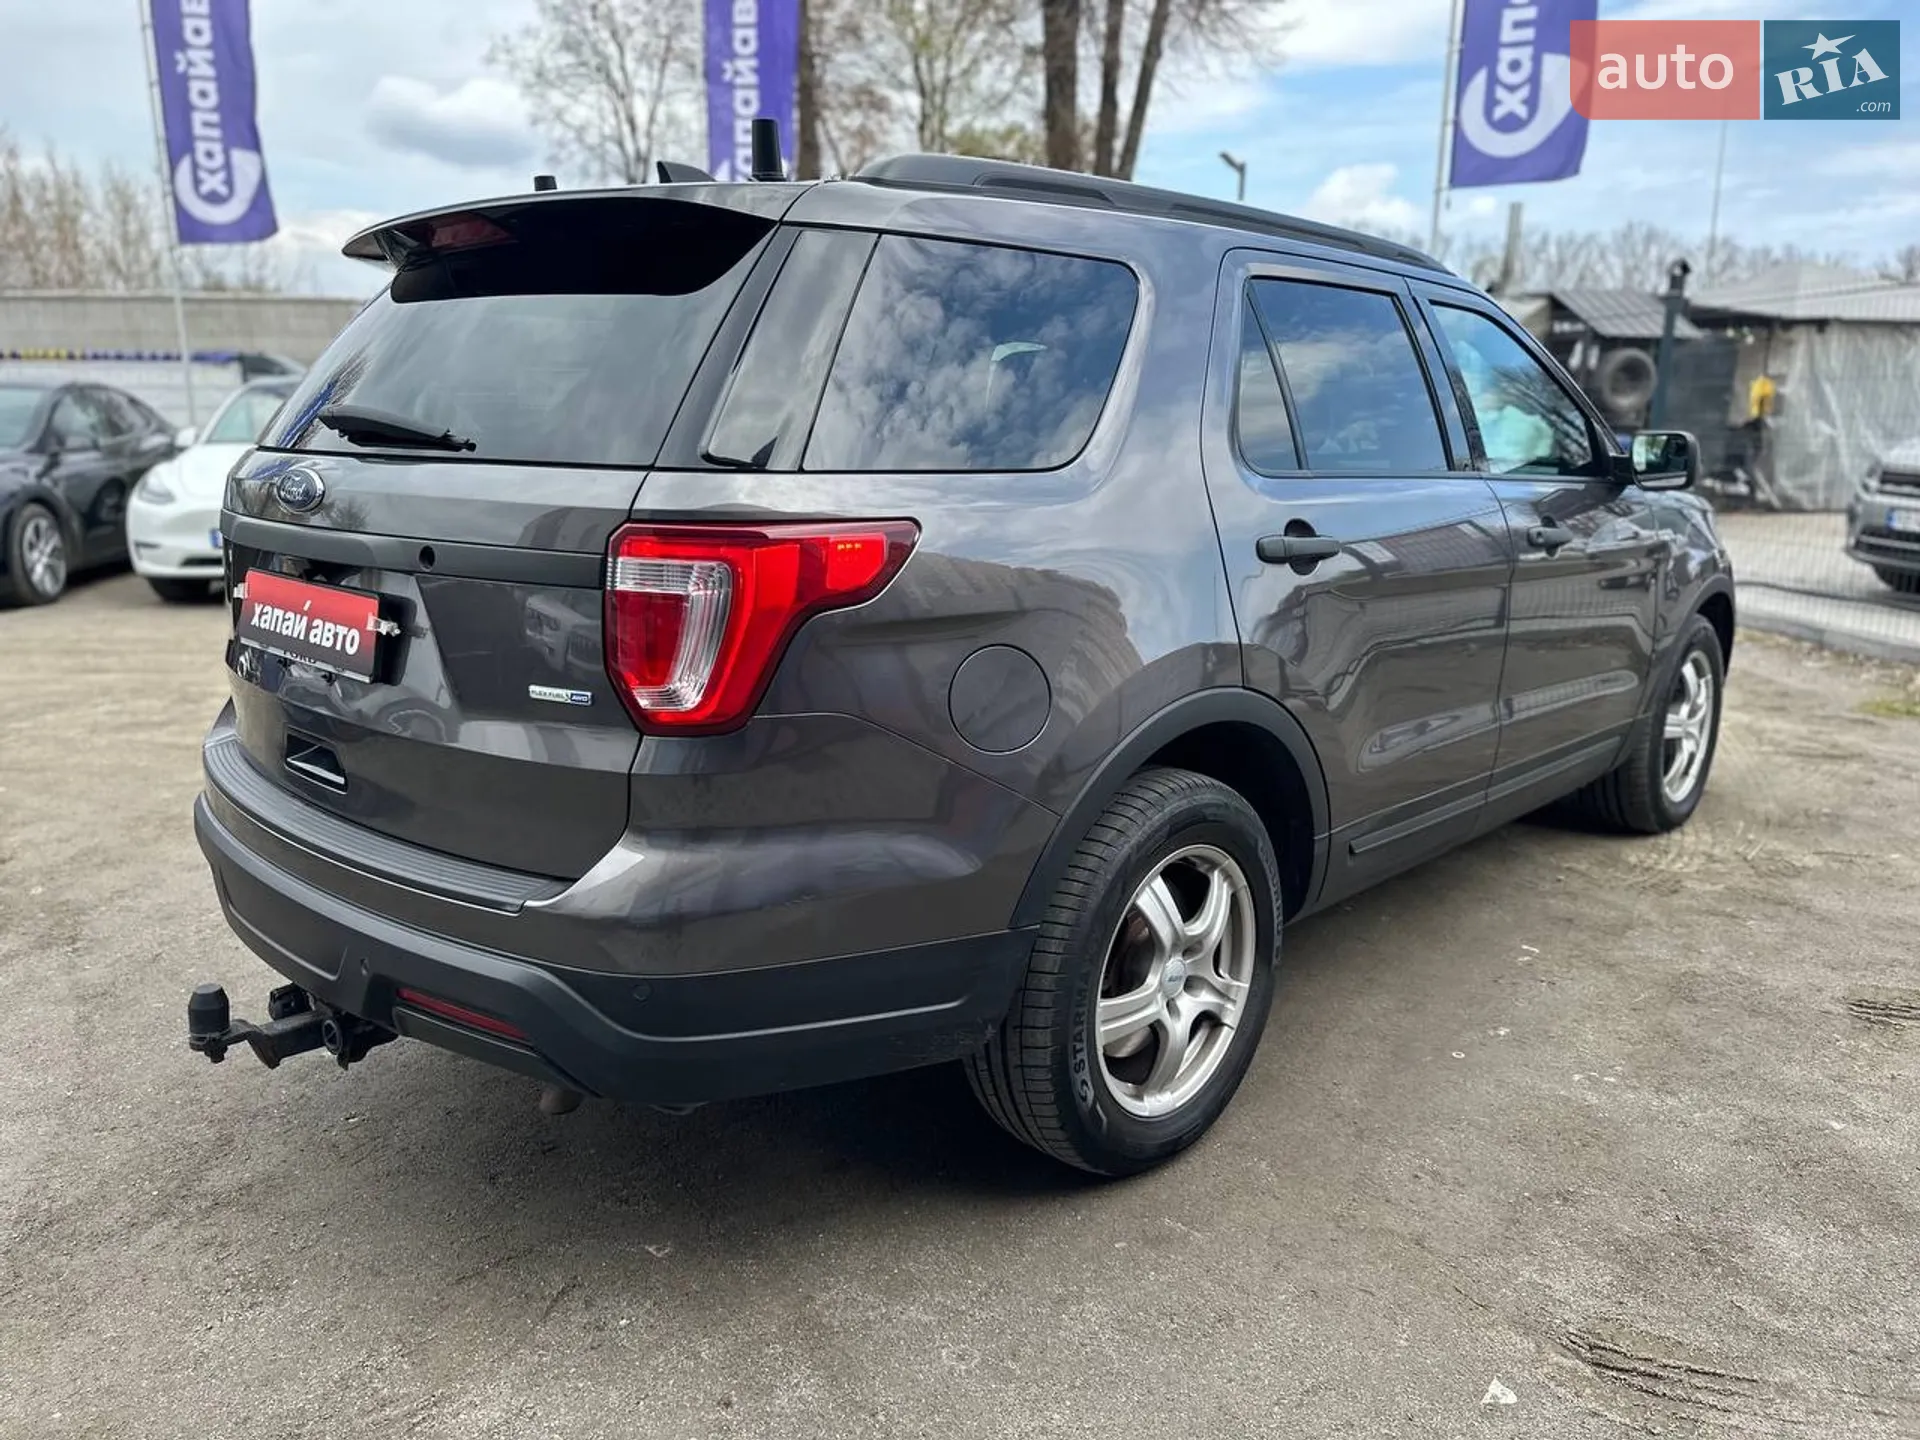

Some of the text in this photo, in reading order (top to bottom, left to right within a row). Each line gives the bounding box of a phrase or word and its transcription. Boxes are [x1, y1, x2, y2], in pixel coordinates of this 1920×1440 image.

[721, 0, 760, 181] апайав
[1494, 0, 1539, 121] хап
[281, 474, 306, 501] Ford
[308, 618, 360, 656] авто
